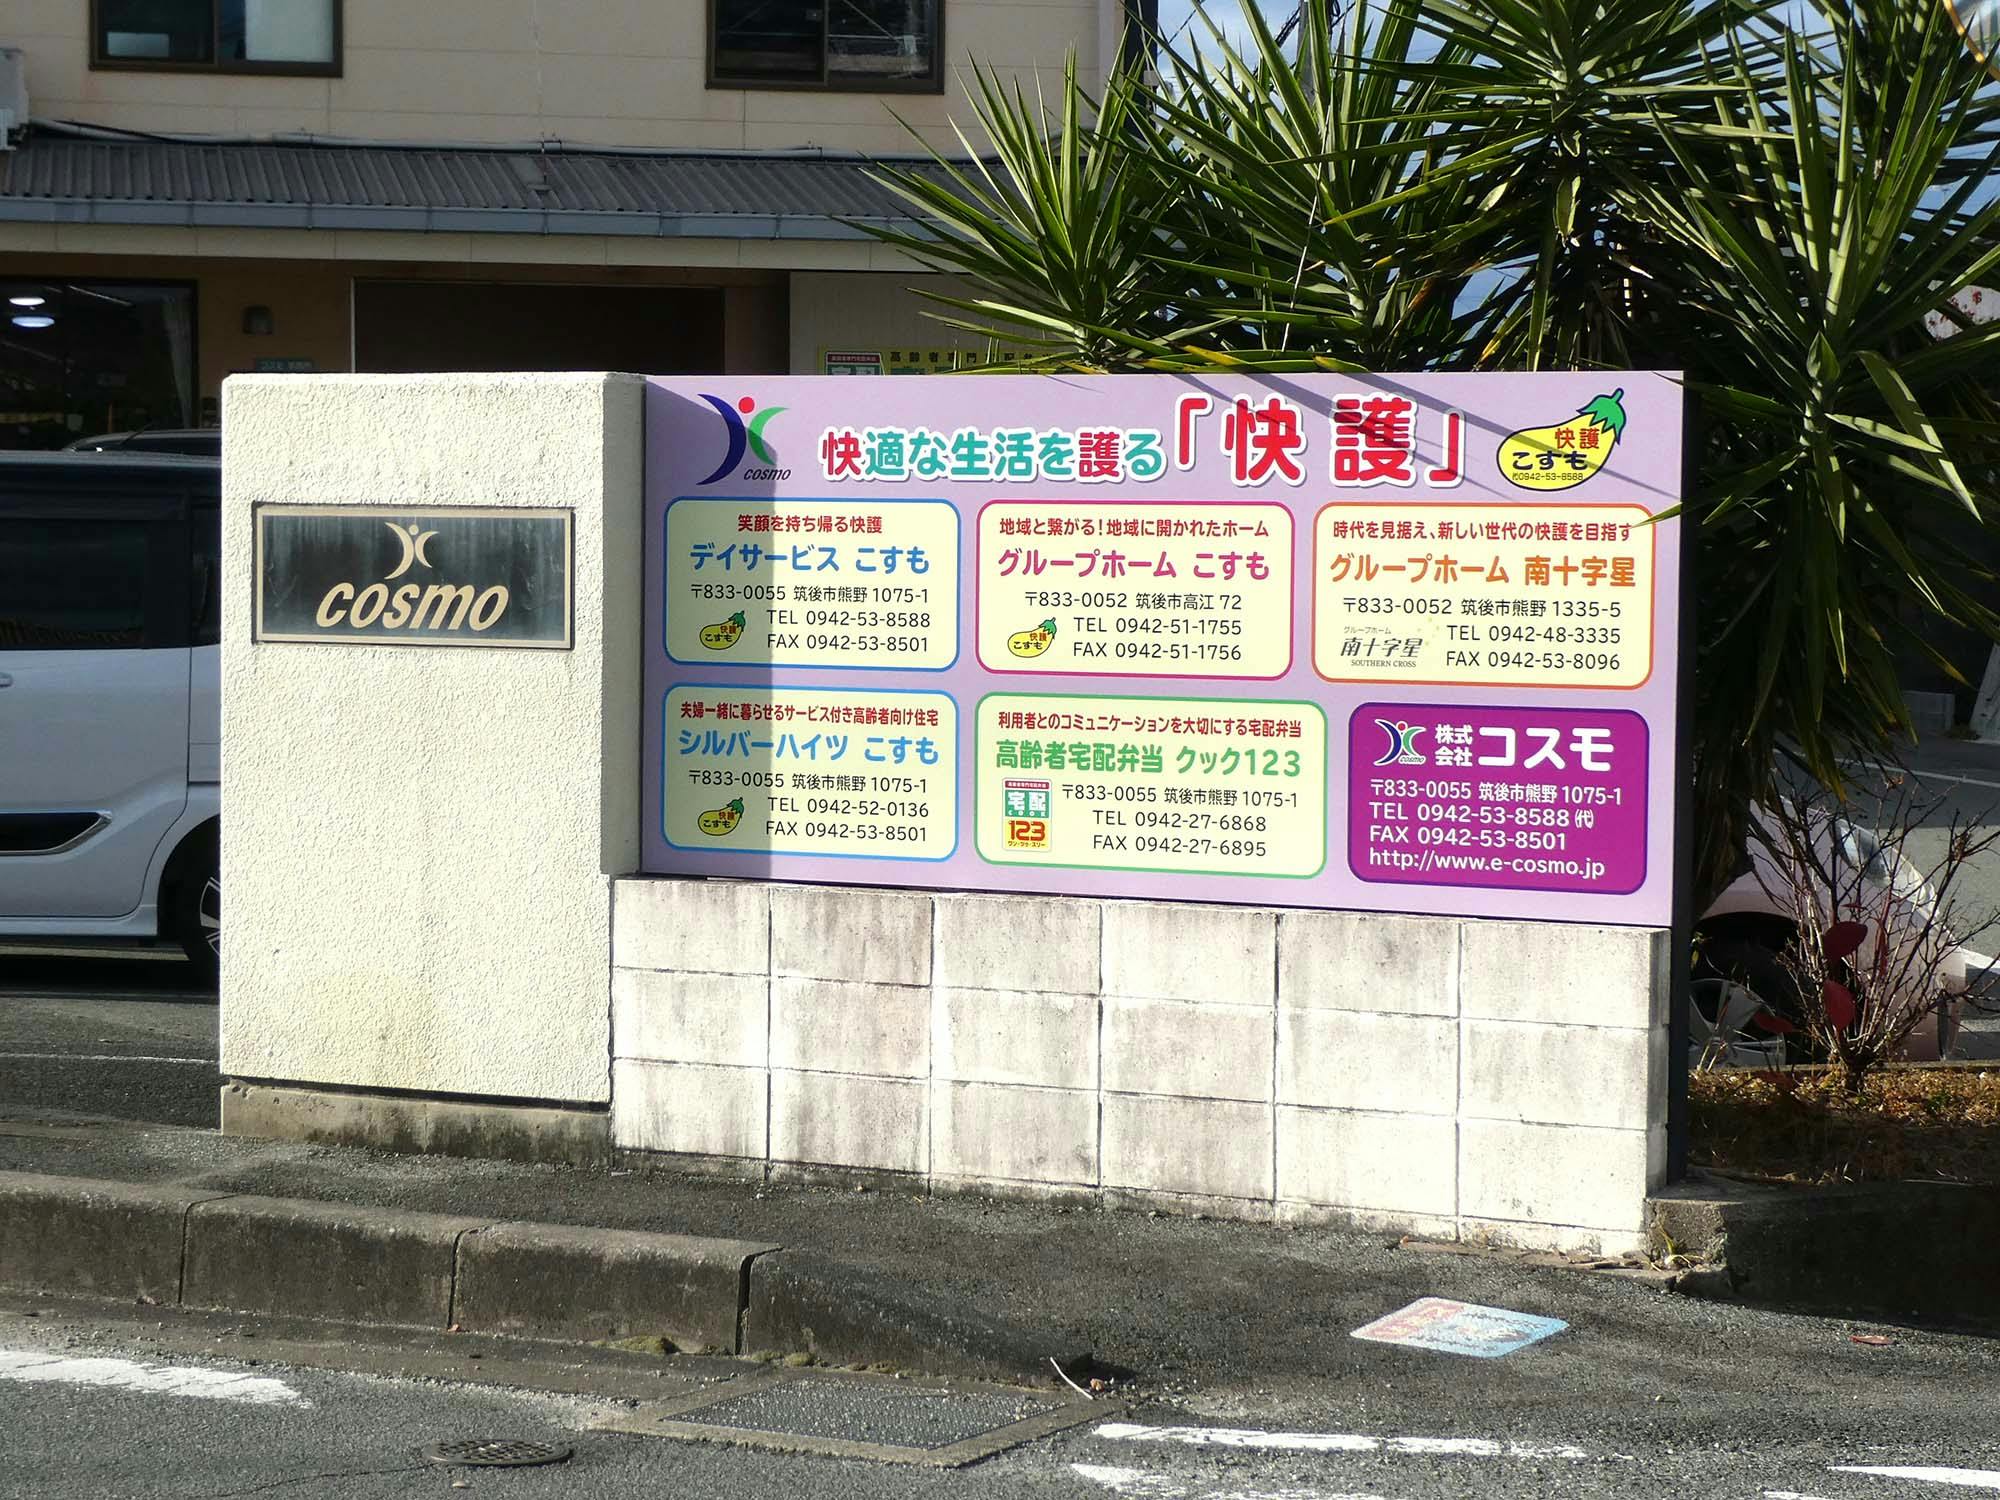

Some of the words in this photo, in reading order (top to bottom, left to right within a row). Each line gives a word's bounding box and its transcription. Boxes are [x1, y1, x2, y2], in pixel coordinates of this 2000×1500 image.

[1554, 427, 1600, 449] 快護
[821, 430, 1162, 478] 快適な生活を護る
[1512, 450, 1588, 470] こすも
[743, 467, 791, 481] cosmo
[738, 514, 883, 534] 笑顔を持ち帰る快護
[999, 517, 1269, 538] 地域と繋がる!地域に開かれたホーム
[1333, 520, 1633, 542] 時代を見据え、新しい世代の快護を目指す
[690, 543, 840, 571] デイサービス
[855, 546, 929, 574] こすも
[998, 548, 1177, 578] グループホーム
[1193, 551, 1270, 581] こすも
[1330, 553, 1509, 584] グループホーム
[1524, 555, 1636, 587] 南十字星
[690, 583, 786, 601] 〒833-0055
[793, 585, 868, 603] 筑後市熊野
[873, 587, 928, 604] 1075-1
[1025, 591, 1128, 608] 〒833-0052
[1135, 592, 1215, 611] 筑後市高江
[1219, 595, 1242, 611] 72
[316, 582, 509, 632] cosmo
[1342, 597, 1452, 615] 〒833-0052
[1461, 598, 1547, 617] 筑後市熊野
[1553, 600, 1621, 618] 1335-5
[766, 609, 798, 625] TEL
[806, 610, 931, 628] 0942-53-8588
[1073, 617, 1107, 633] TEL
[1115, 617, 1242, 636] 0942-51-1755
[705, 633, 732, 642] こすも
[767, 634, 799, 649] FAX
[806, 634, 928, 652] 0942-53-8501
[1446, 625, 1480, 641] TEL
[1488, 625, 1621, 644] 0942-48-3335
[1013, 641, 1043, 650] こすも
[1073, 642, 1107, 657] FAX
[1115, 643, 1242, 661] 0942-51-1756
[1340, 637, 1423, 658] 南十字星
[1350, 659, 1391, 667] SOUTHERN
[1393, 660, 1417, 668] CROSS
[1446, 650, 1480, 667] FAX
[1488, 651, 1620, 670] 0942-53-8096
[680, 701, 939, 727] 夫婦一緒に暮らせるサービス付き高齢者向け住宅
[998, 711, 1302, 738] 利用者とのコミュニケーションを大切にする宅配弁当
[1435, 724, 1473, 745] 株式
[679, 729, 849, 761] シルバーハイツ
[864, 736, 939, 765] こすも
[1435, 746, 1473, 767] 会社
[1478, 726, 1614, 772] コスモ
[996, 739, 1163, 774] 高齢者宅配弁当
[1176, 745, 1301, 777] クック123
[688, 769, 784, 788] 〒833-0055
[791, 773, 867, 792] 筑後市熊野
[871, 777, 927, 793] 1075-1
[1370, 778, 1471, 799] 〒833-0055
[1478, 782, 1558, 804] 筑後市熊野
[1562, 785, 1621, 805] 1075-1
[1007, 791, 1046, 811] 宅配
[1061, 784, 1157, 802] 〒833-0055
[1164, 787, 1238, 807] 筑後市熊野
[1244, 790, 1298, 808] 1075-1
[768, 796, 799, 812] TEL
[807, 798, 929, 818] 0942-52-0136
[1369, 801, 1408, 820] TEL
[1417, 804, 1569, 827] 0942-53-8588
[703, 819, 731, 828] こすも
[766, 820, 798, 836] FAX
[805, 822, 927, 842] 0942-53-8501
[1008, 820, 1046, 841] 123
[1093, 810, 1127, 826] TEL
[1135, 811, 1267, 832] 0942-27-6868
[1093, 835, 1127, 851] FAX
[1135, 836, 1266, 857] 0942-27-6895
[1369, 825, 1409, 844] FAX
[1417, 828, 1566, 850] 0942-53-8501
[1369, 848, 1605, 880] http://www.e-cosmo.jp
